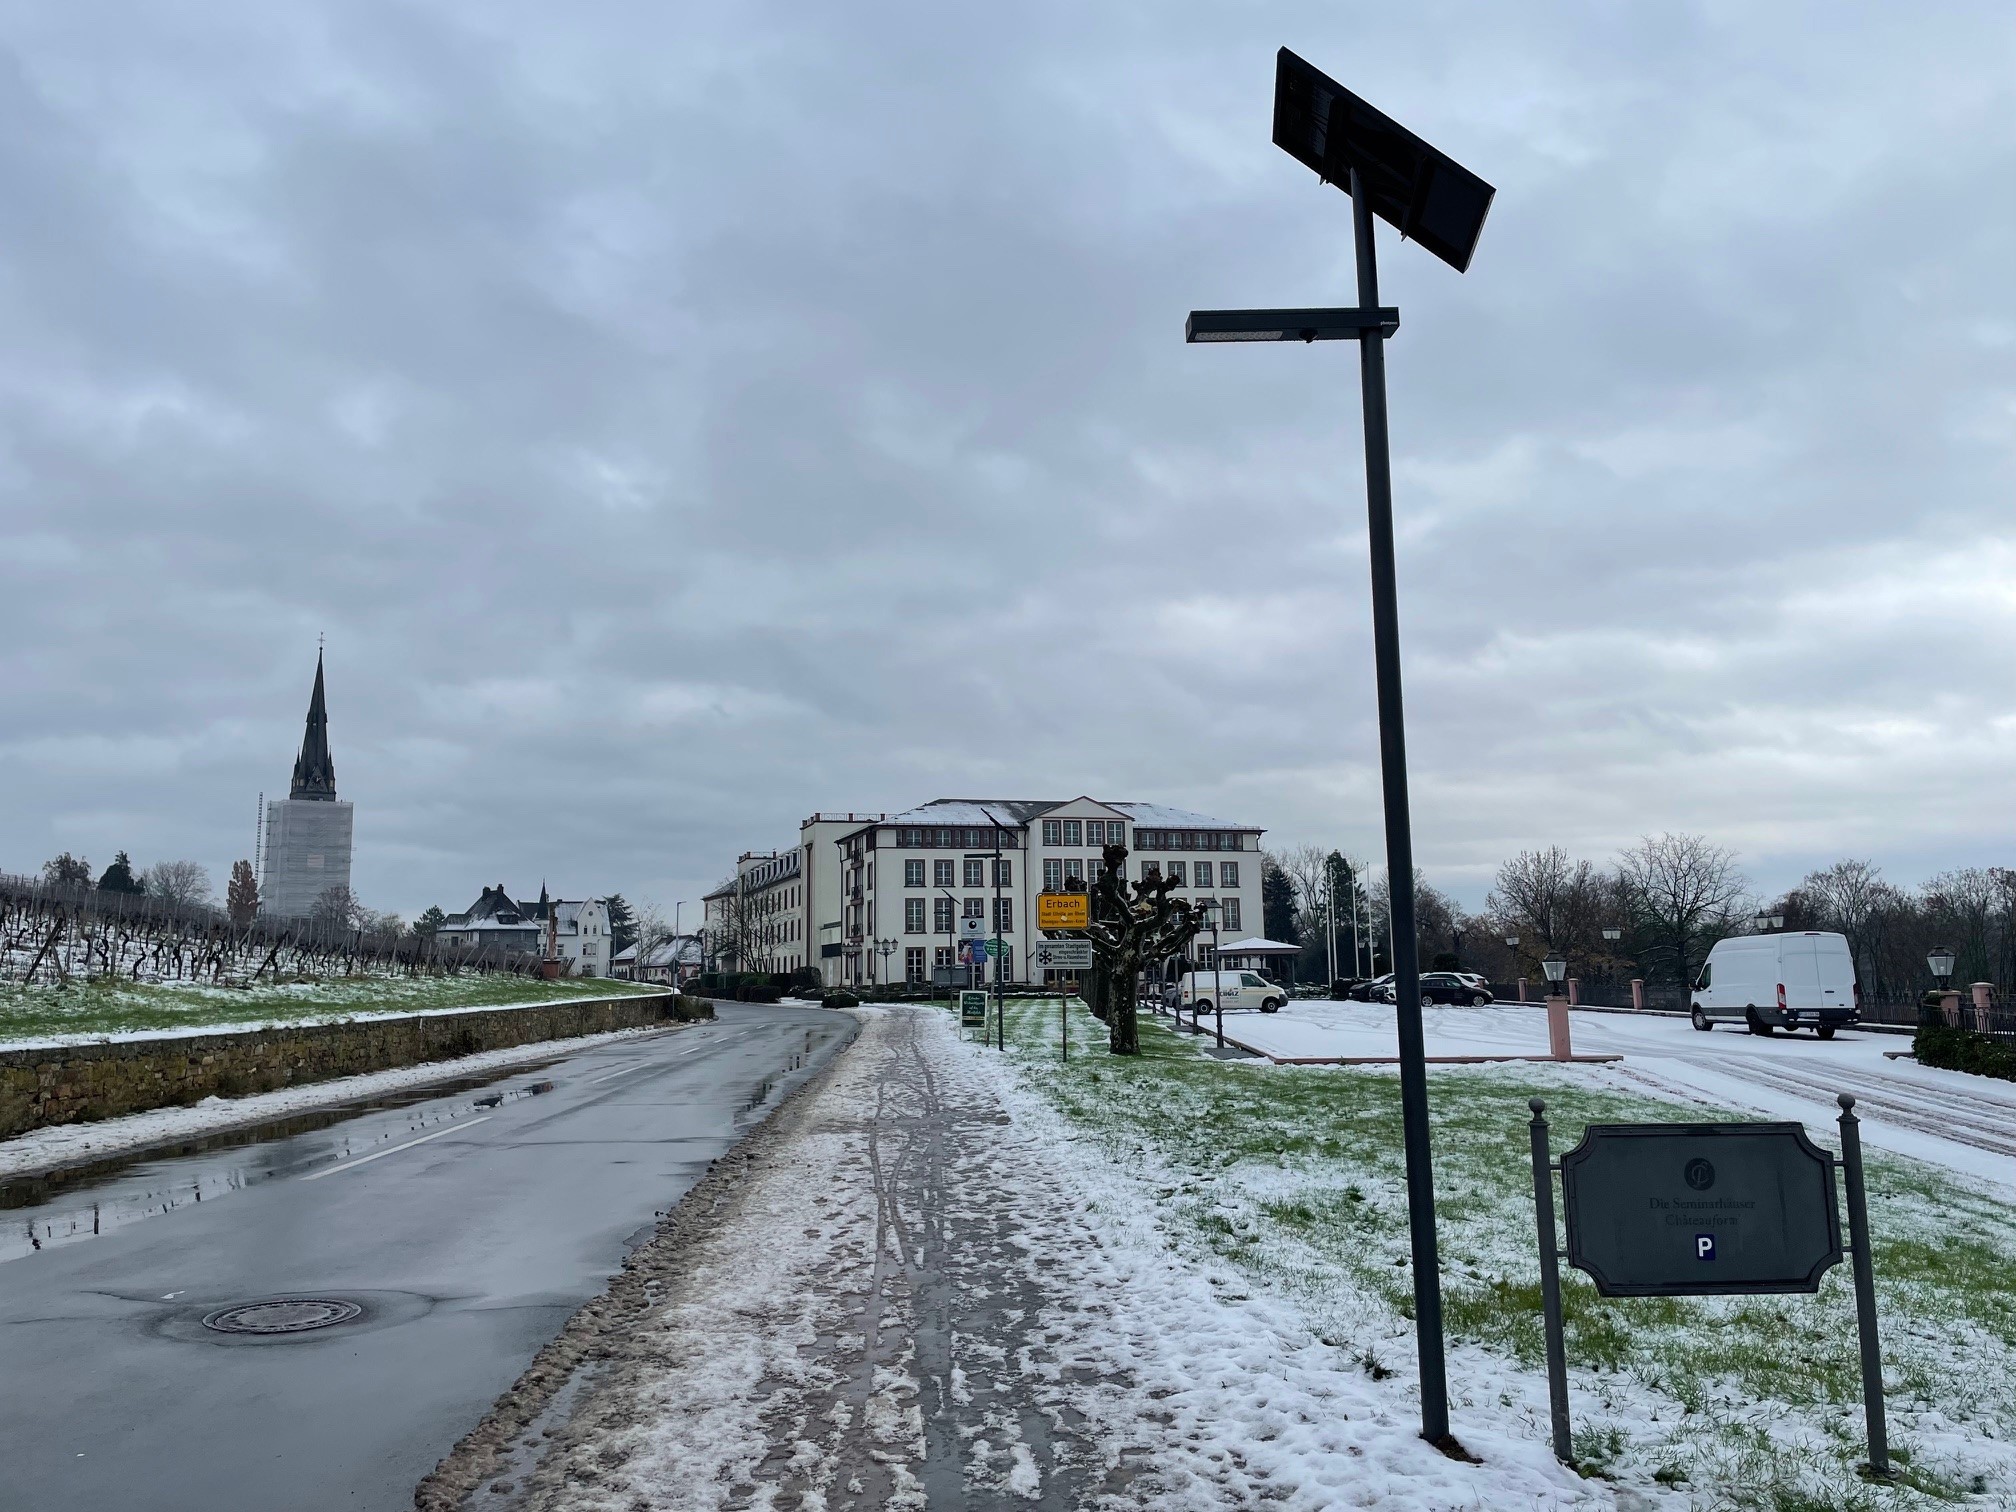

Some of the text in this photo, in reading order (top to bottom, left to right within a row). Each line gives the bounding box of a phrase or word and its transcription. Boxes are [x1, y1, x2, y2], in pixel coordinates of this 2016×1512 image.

[1046, 899, 1080, 908] Erbach
[1649, 1197, 1756, 1210] Die Seminarhäuser
[1697, 1237, 1713, 1257] P
